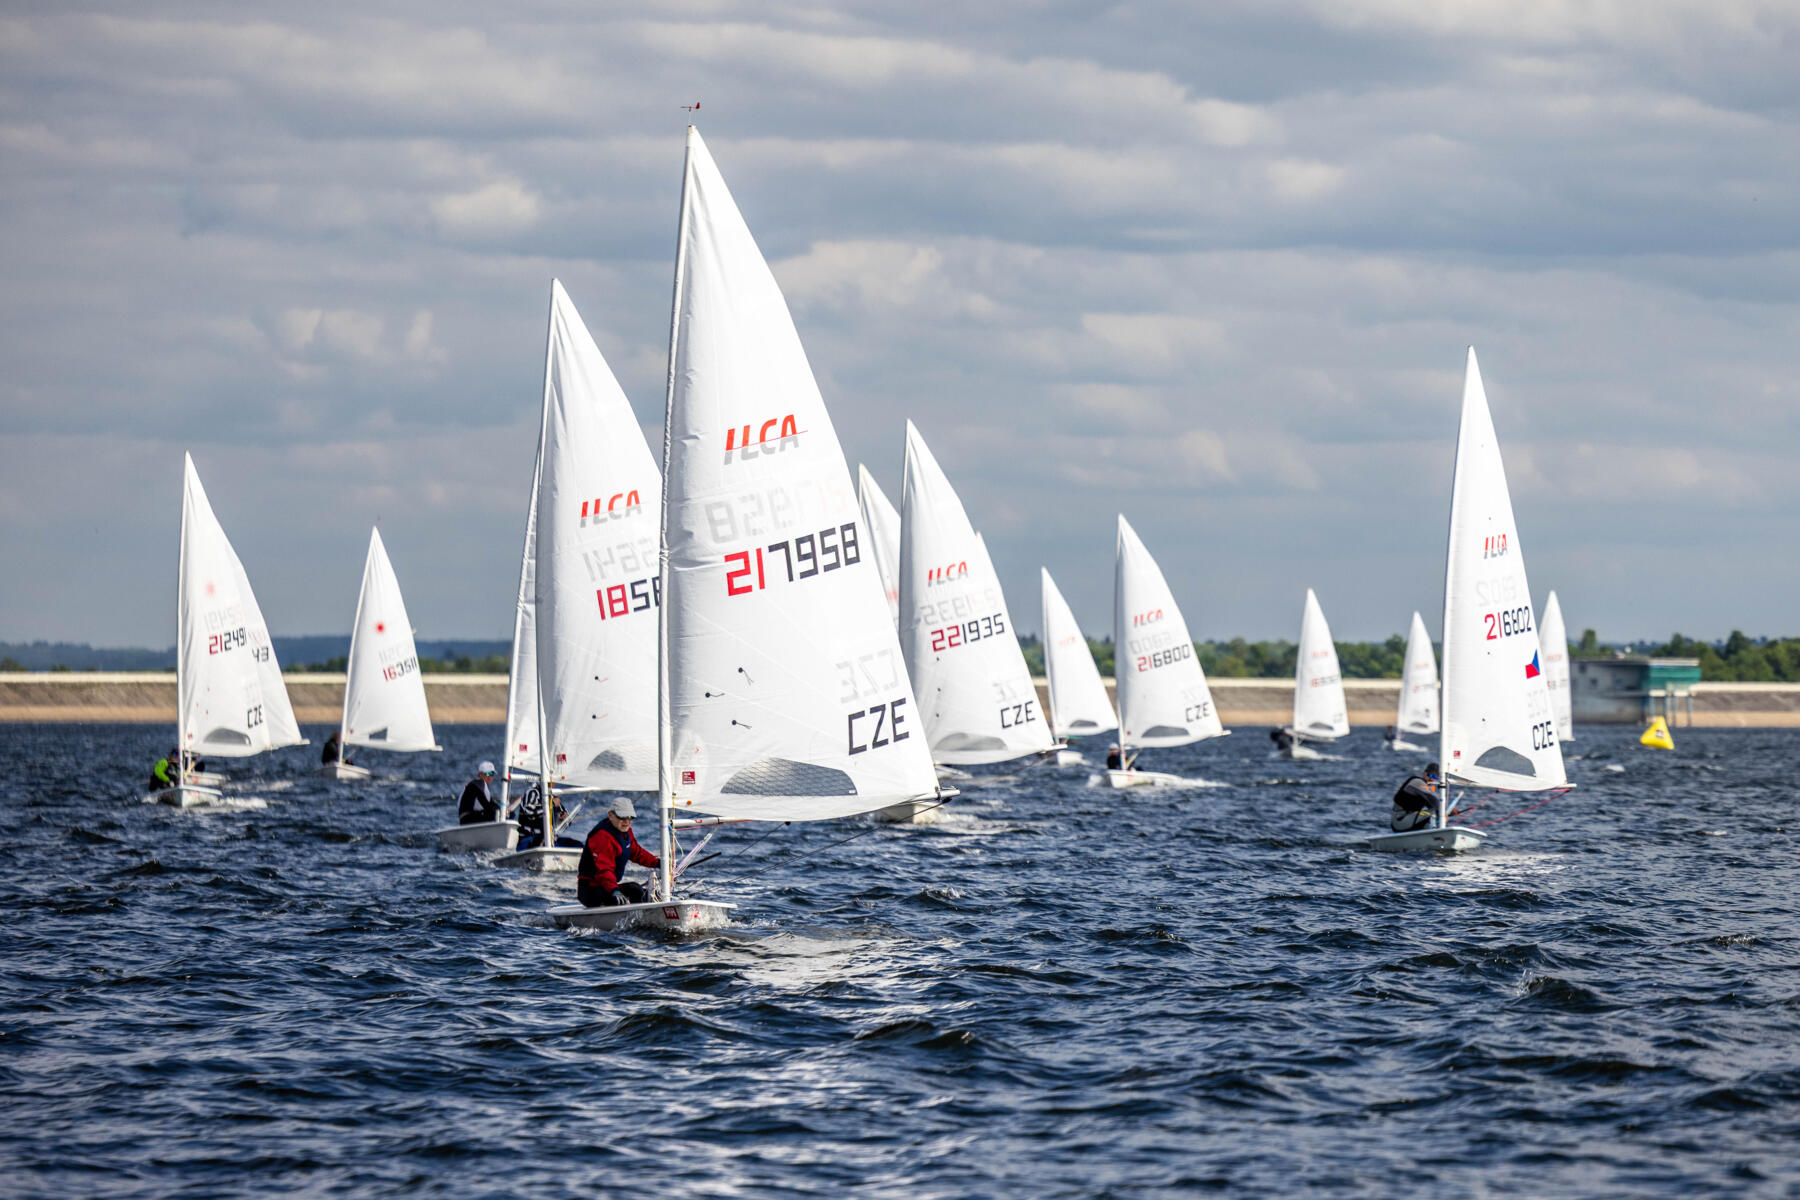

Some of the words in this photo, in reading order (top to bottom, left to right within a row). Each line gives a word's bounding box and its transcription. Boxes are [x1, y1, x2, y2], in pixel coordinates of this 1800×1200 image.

[724, 414, 799, 465] ILCA
[580, 489, 642, 528] ILCA
[724, 522, 861, 596] 217958
[928, 561, 969, 587] ILCA
[931, 613, 1005, 652] 221935
[1133, 609, 1164, 628] ILCA
[1484, 605, 1532, 641] 216802
[1137, 644, 1191, 672] 216800
[247, 704, 263, 729] CZE
[848, 697, 909, 756] CZE
[1000, 701, 1035, 729] CZE
[1184, 702, 1210, 723] CZE
[1532, 721, 1554, 751] CZE
